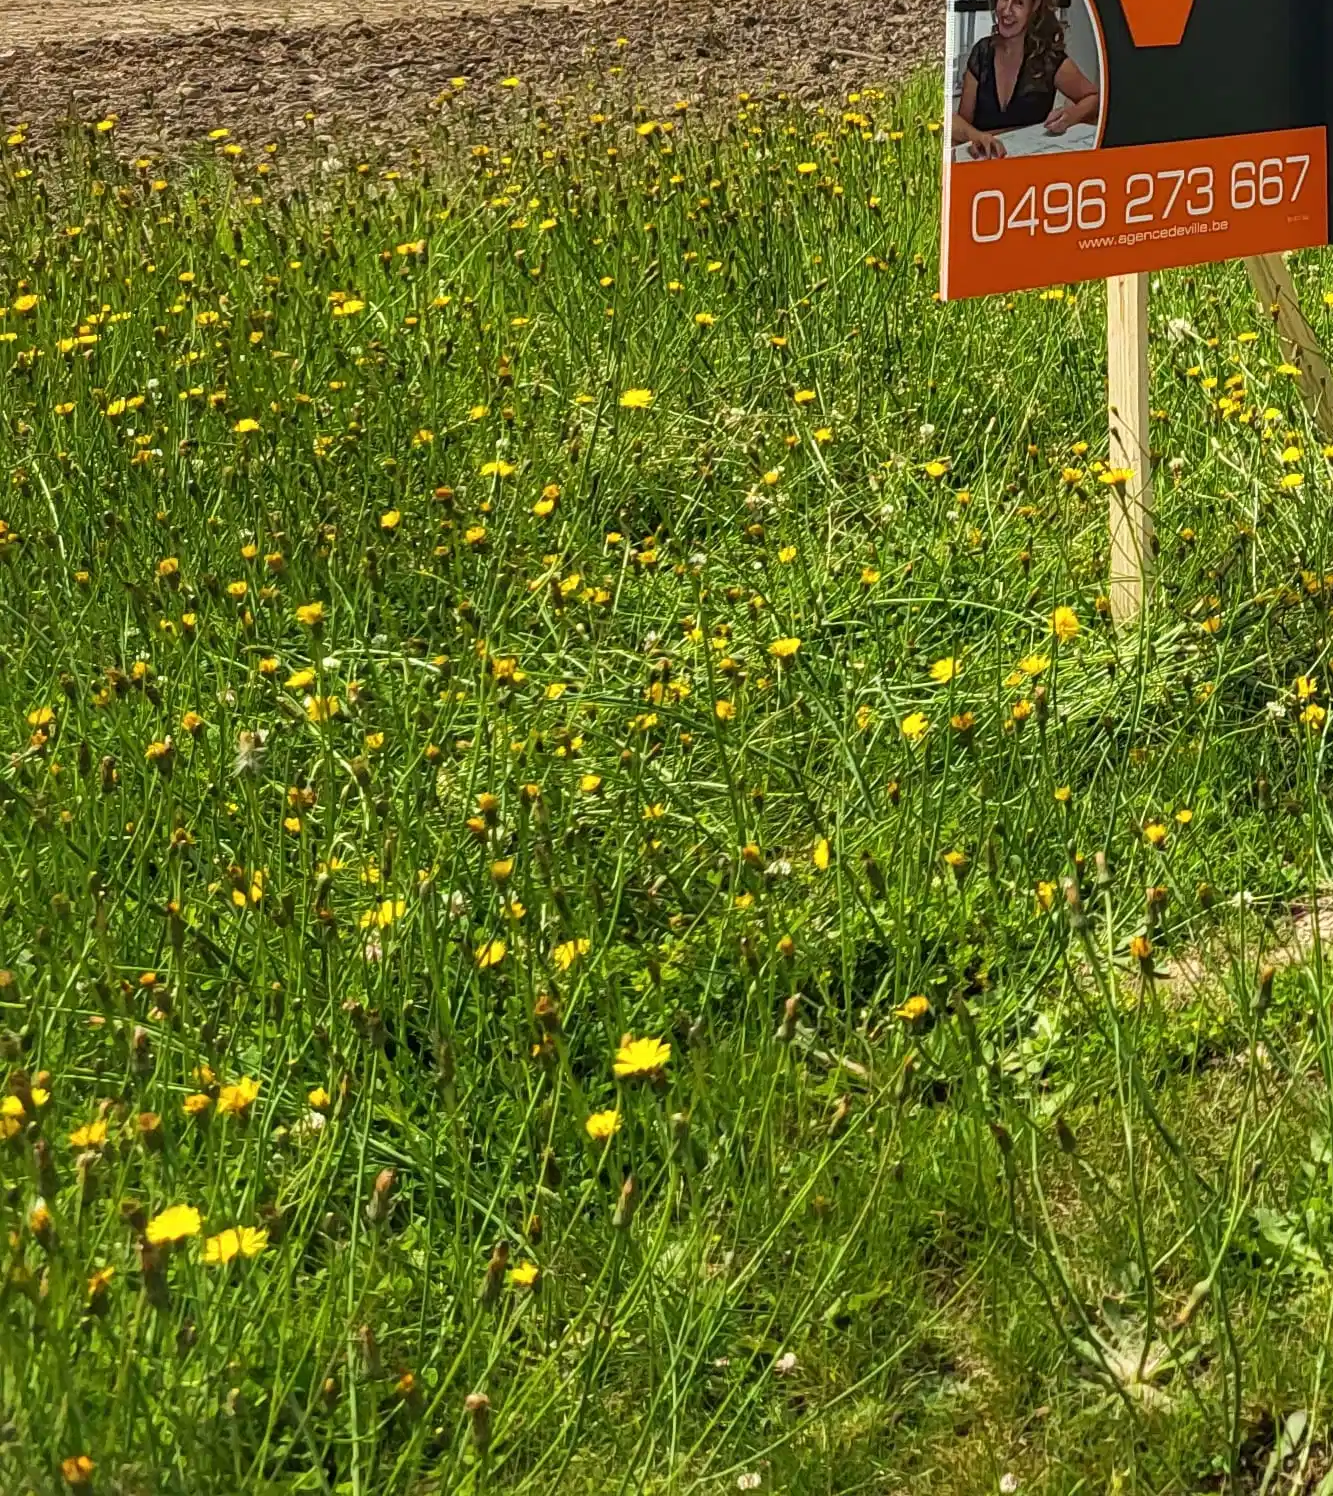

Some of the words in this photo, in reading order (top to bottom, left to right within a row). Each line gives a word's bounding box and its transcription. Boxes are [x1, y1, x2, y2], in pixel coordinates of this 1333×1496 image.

[971, 178, 1106, 243] 0496
[1125, 166, 1213, 223] 273
[1231, 154, 1310, 210] 667
[1078, 220, 1228, 250] www.agencedeville.be
